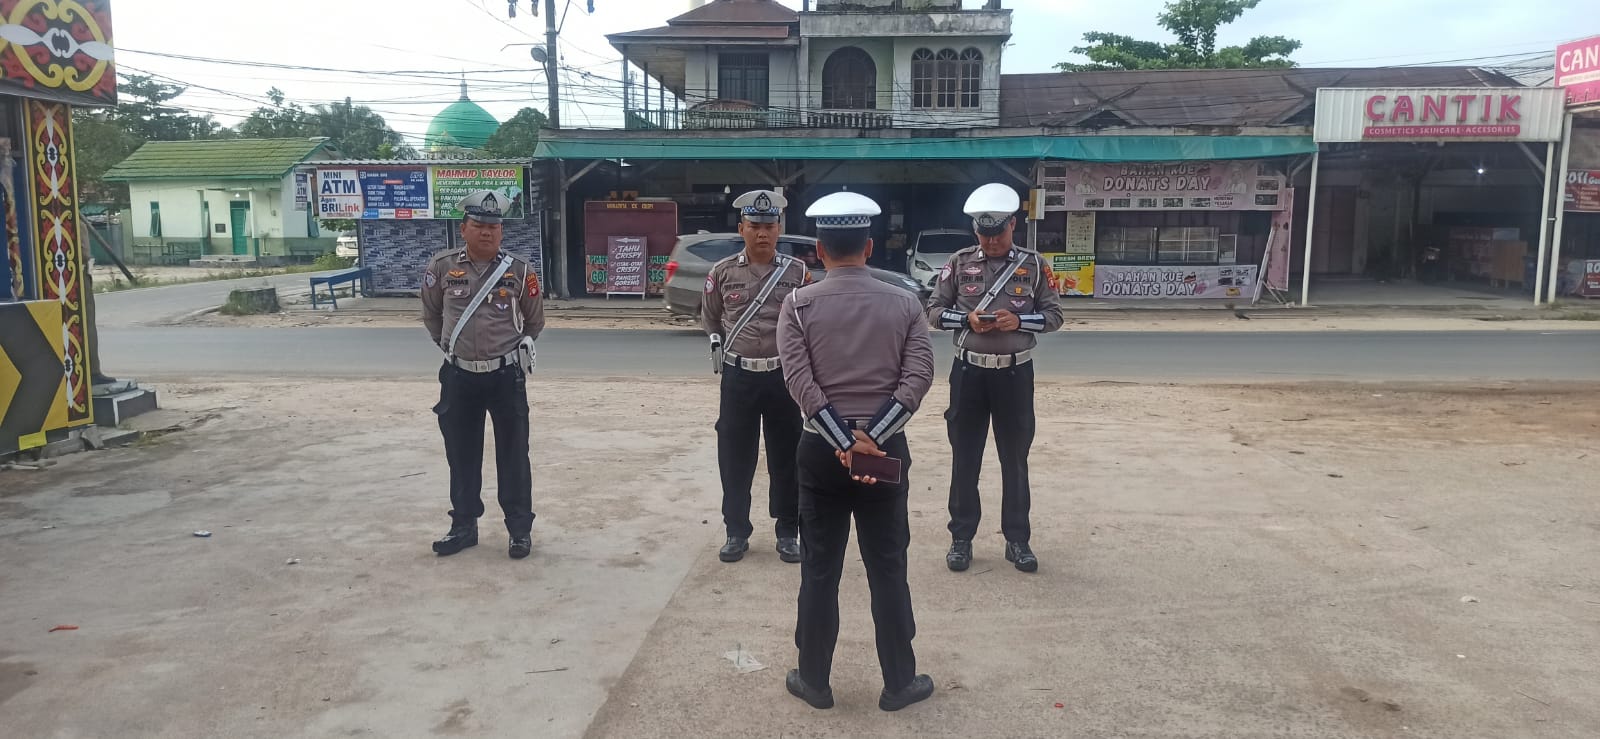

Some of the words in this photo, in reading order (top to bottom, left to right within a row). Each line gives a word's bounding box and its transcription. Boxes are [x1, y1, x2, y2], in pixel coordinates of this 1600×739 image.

[1366, 95, 1522, 122] CANTIK
[1369, 127, 1415, 135] COSMETICS
[1419, 127, 1461, 135] SKINCARE
[1465, 126, 1515, 134] ACCESORIES
[323, 171, 341, 179] MINI
[437, 169, 478, 179] MAHMUD
[481, 169, 516, 179] TAYLOR
[1566, 171, 1589, 184] OTI
[321, 180, 356, 194] ATM
[1103, 176, 1170, 191] DONATS
[1176, 176, 1211, 191] DAY
[321, 203, 360, 213] BRILink
[618, 245, 640, 253] TAHU
[1117, 271, 1157, 282] BAHAN
[1161, 271, 1184, 282] KUE
[1102, 282, 1161, 295] DONATS
[1166, 282, 1197, 295] DAY
